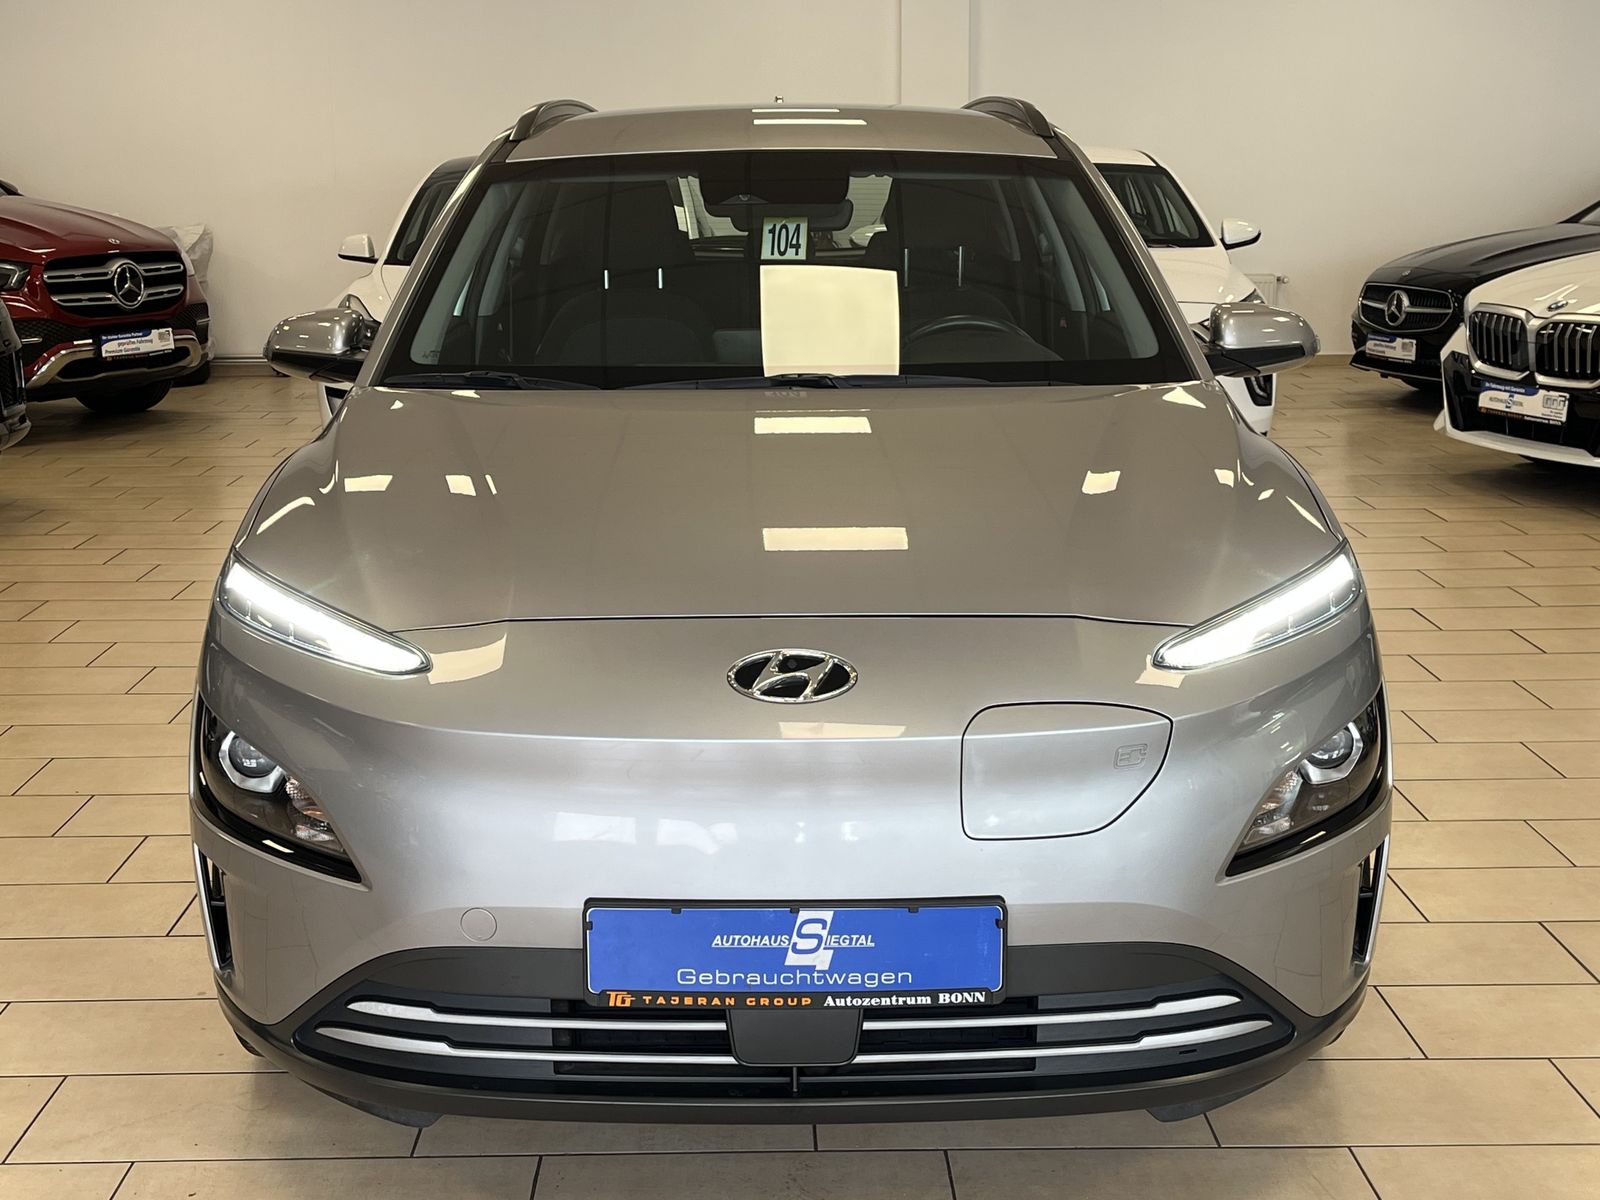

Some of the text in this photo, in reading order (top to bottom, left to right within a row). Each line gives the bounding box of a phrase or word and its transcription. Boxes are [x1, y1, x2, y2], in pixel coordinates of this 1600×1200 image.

[768, 223, 802, 257] 104
[712, 935, 790, 947] AUTOHAUS
[677, 968, 912, 988] Gebrauchtwagen
[643, 996, 735, 1006] TAJERAN
[746, 996, 812, 1006] GROUP
[824, 994, 932, 1007] Autozentrum
[938, 992, 986, 1004] BONN
